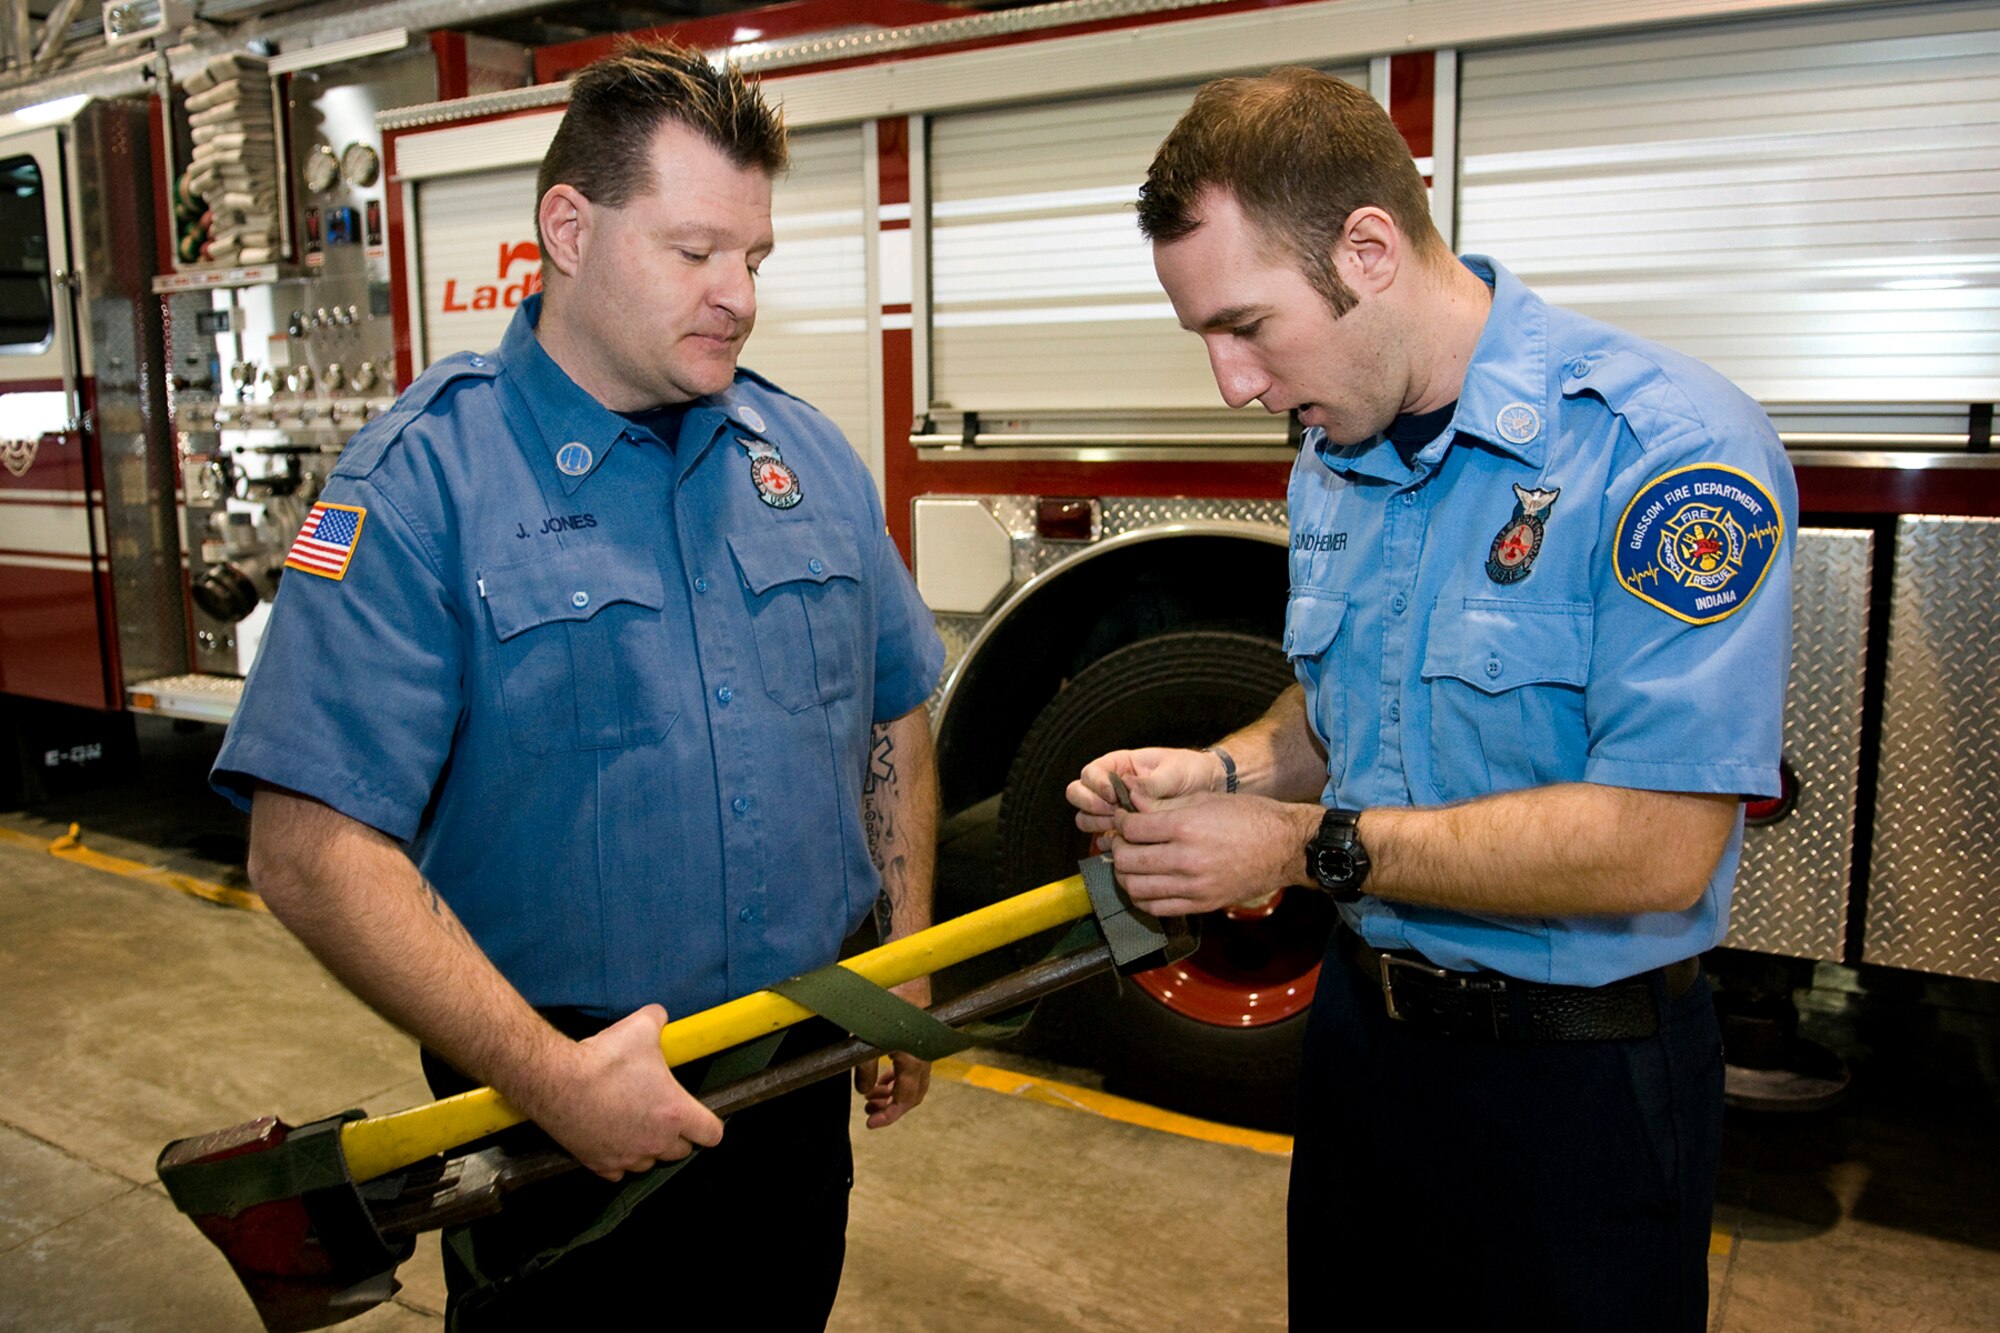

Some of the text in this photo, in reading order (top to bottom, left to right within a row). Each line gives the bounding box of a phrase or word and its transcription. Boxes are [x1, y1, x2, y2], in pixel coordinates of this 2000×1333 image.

[516, 513, 598, 539] J. JONES
[1631, 482, 1763, 550] GRISSOM FIRE DEPARTMENT
[1680, 509, 1709, 524] FIRE
[1663, 536, 1683, 574] HAZMAT
[1693, 569, 1731, 586] RESCUE
[1695, 590, 1737, 611] INDIANA
